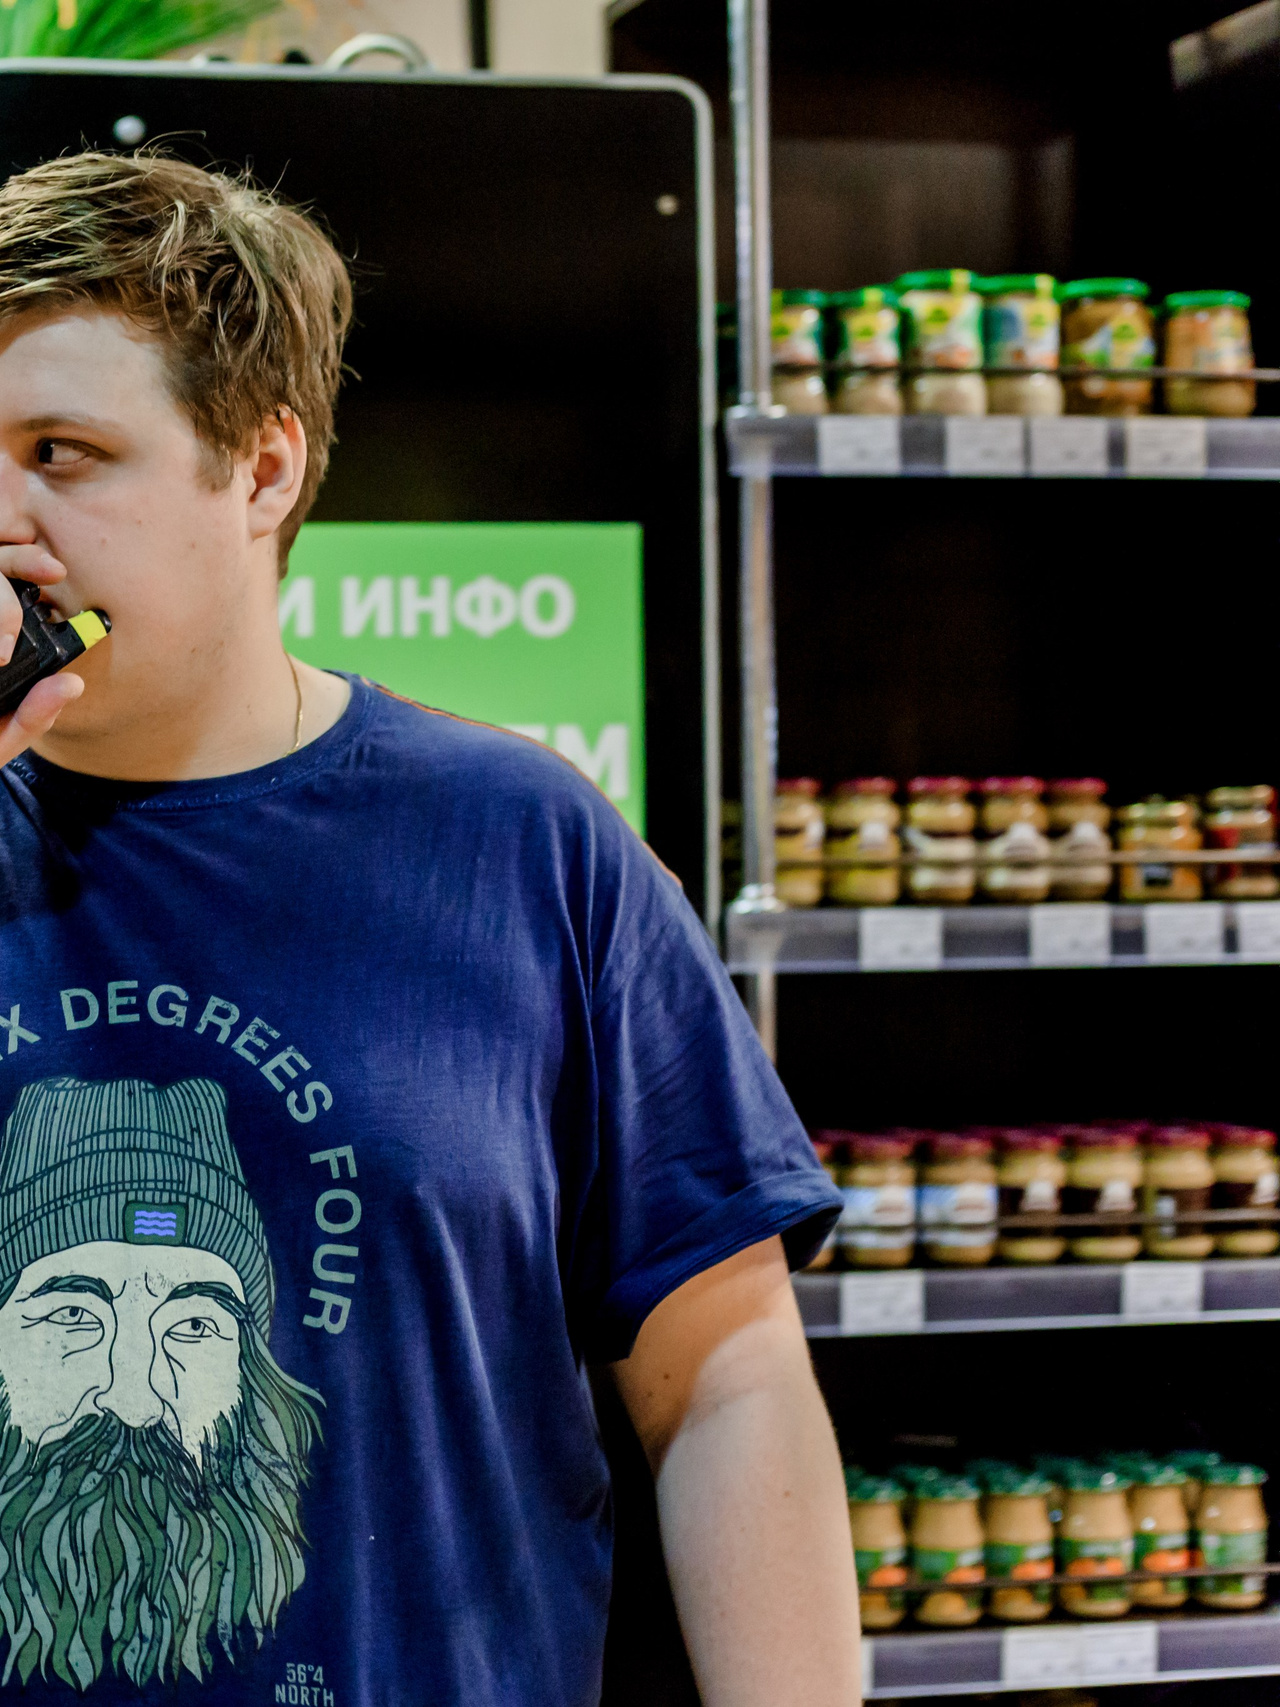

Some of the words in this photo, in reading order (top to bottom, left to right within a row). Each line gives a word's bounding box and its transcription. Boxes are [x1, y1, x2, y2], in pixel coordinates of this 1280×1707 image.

[340, 574, 576, 639] ИНФО
[59, 980, 334, 1124] DEGREES
[303, 1145, 362, 1336] FOUR
[275, 1683, 335, 1707] NORTH
